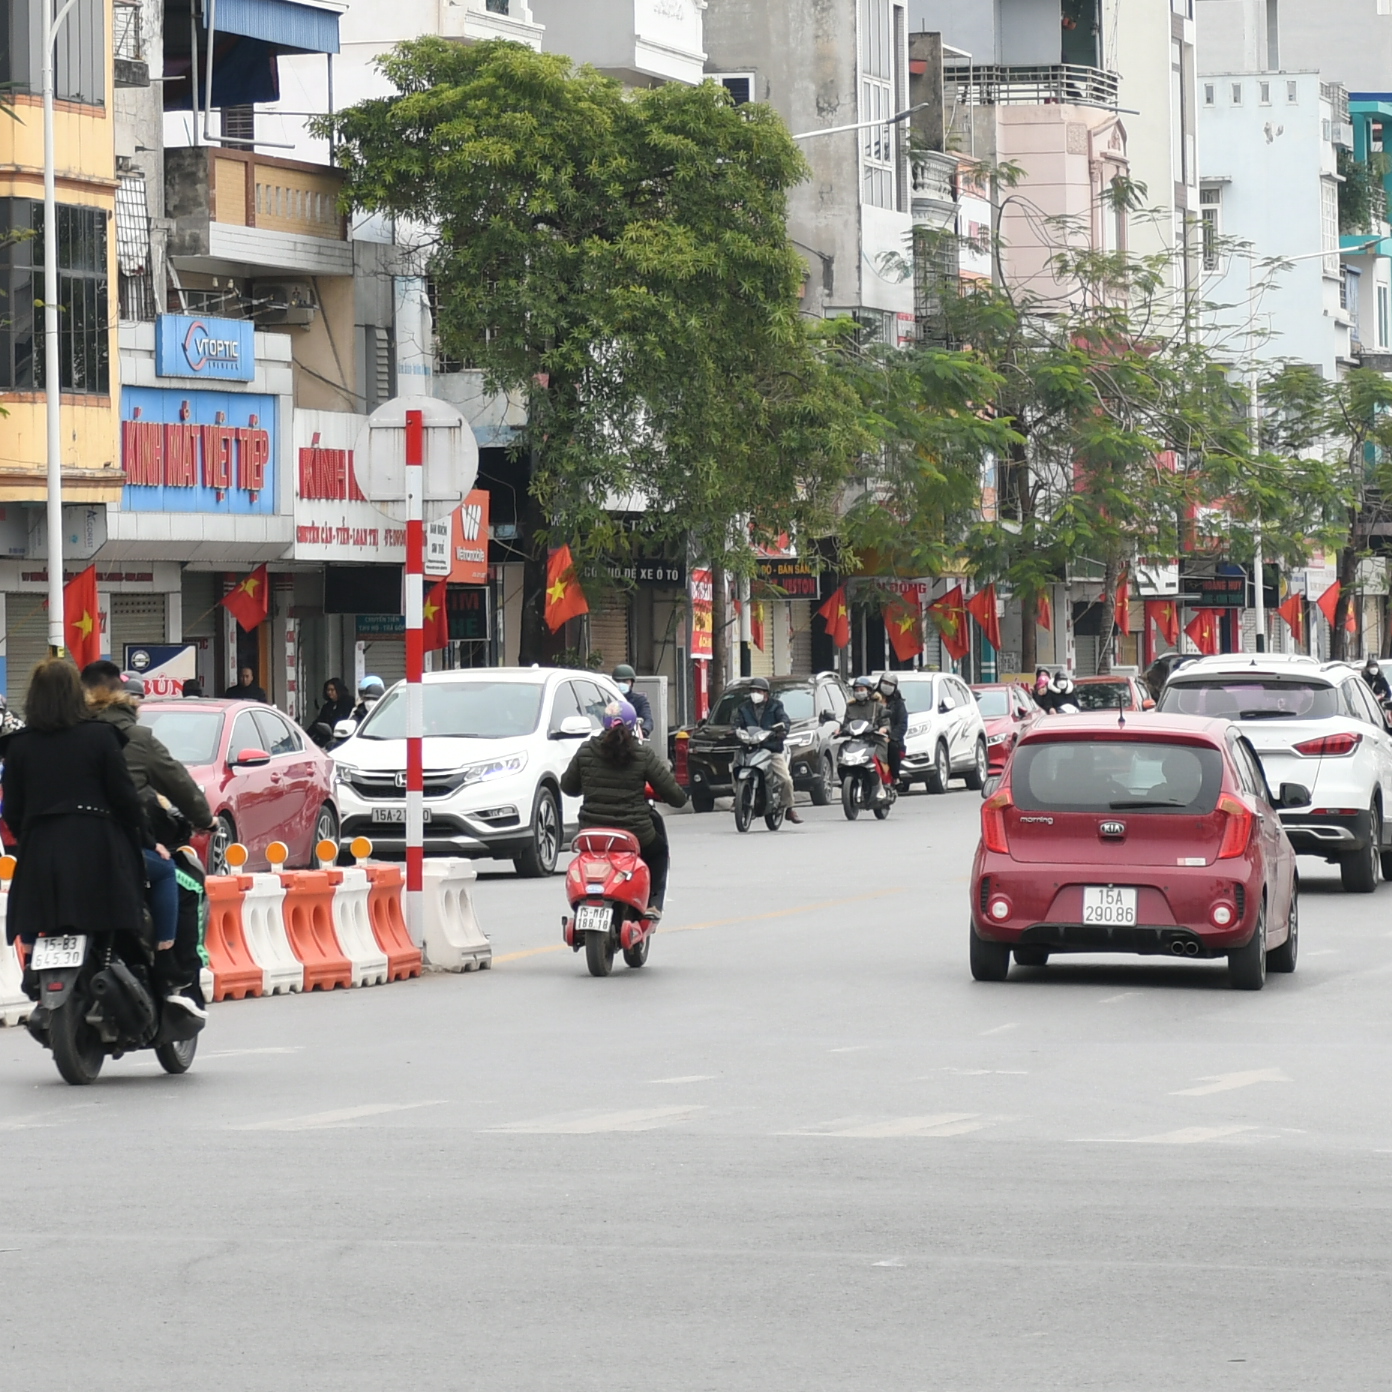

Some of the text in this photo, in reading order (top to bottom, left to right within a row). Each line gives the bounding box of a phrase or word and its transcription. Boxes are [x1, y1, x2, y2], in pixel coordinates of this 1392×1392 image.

[122, 406, 163, 486] KÍNH
[298, 432, 347, 501] KÍNH
[640, 568, 654, 580] XE
[656, 566, 663, 580] Ô
[666, 567, 679, 581] TÔ
[1019, 816, 1054, 825] morning
[1103, 824, 1122, 834] KIA
[1098, 889, 1123, 906] 15A
[1085, 906, 1134, 923] 290.86
[44, 937, 77, 951] 15-B3
